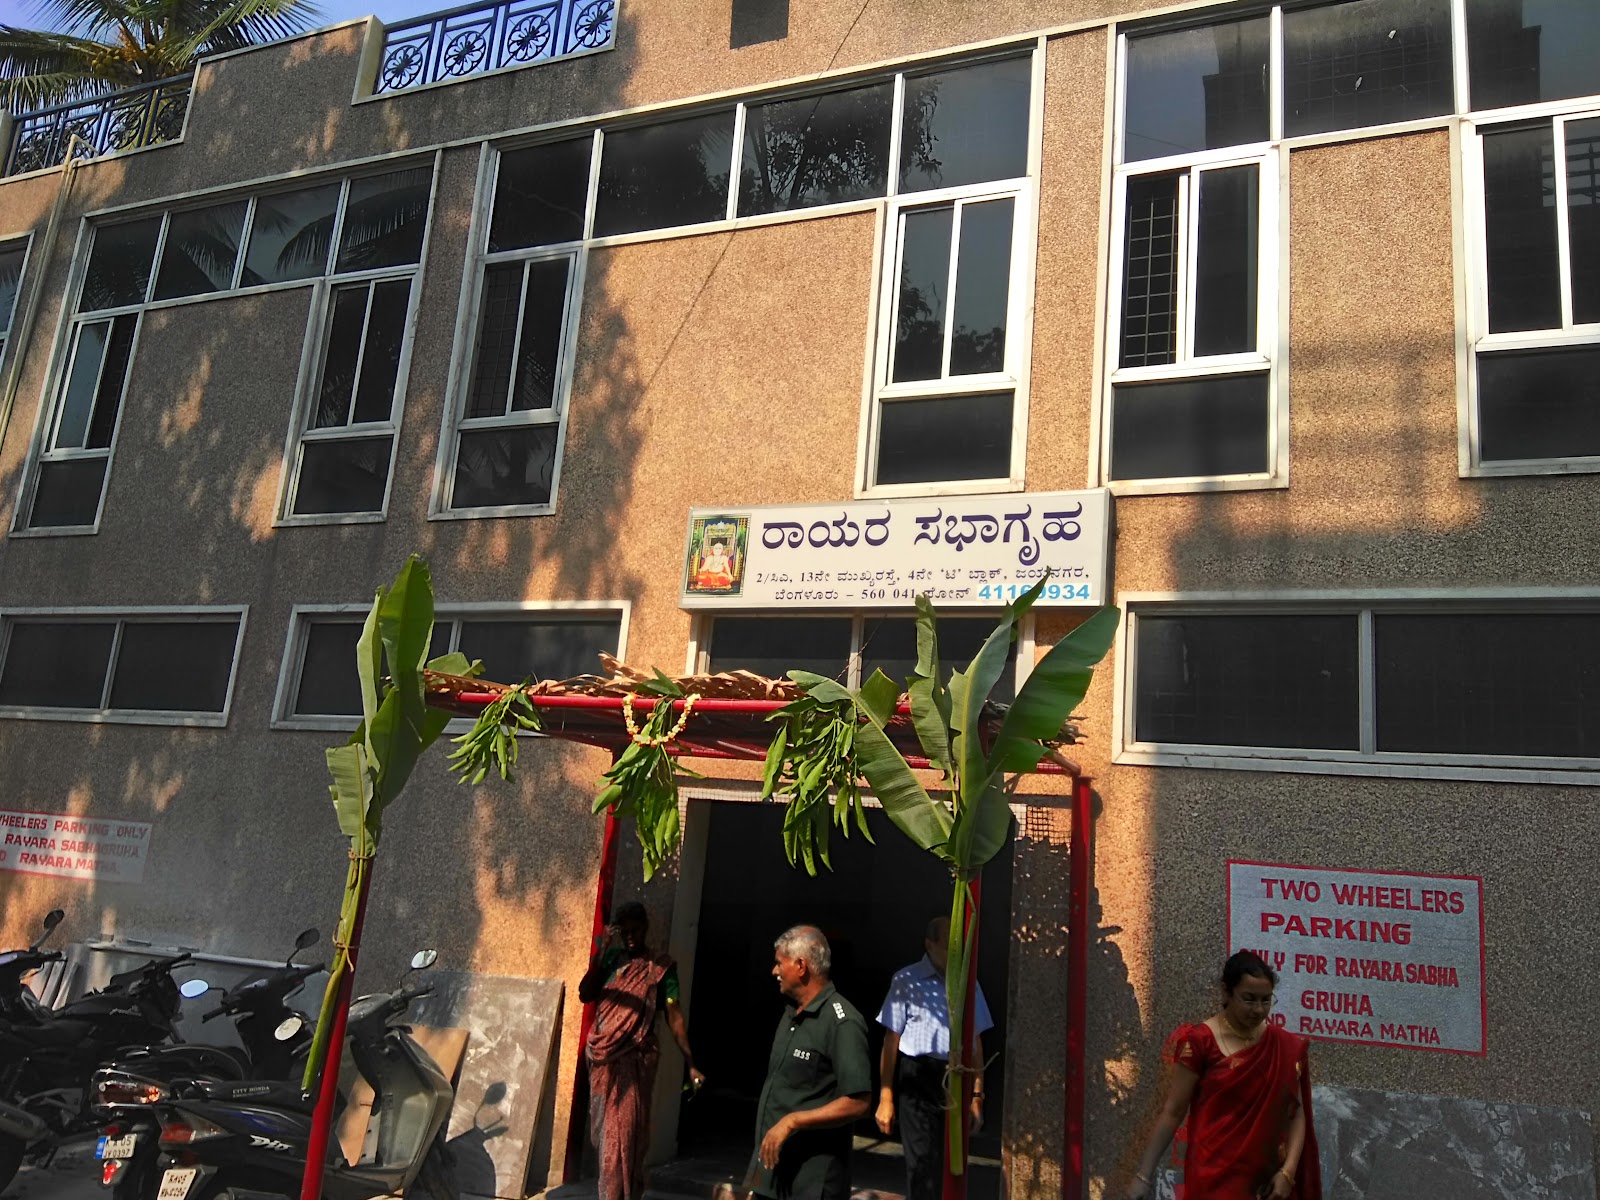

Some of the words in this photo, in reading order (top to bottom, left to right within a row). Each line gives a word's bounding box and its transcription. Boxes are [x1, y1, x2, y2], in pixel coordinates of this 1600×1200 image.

[762, 509, 891, 549] ರಾಯರ
[914, 501, 1083, 566] ಸಭಾಗೃಹ
[800, 570, 830, 583] 13ನೇ
[908, 568, 932, 580] 4ನೇ
[775, 588, 838, 600] ಬೆಂಗಳೂರು
[861, 589, 885, 600] 560
[893, 588, 915, 599] 041
[5, 834, 56, 850] RAYARA
[54, 820, 109, 836] PARKING
[116, 826, 148, 840] ONLY
[19, 853, 72, 869] RAYARA
[1261, 878, 1321, 902] TWO
[1331, 883, 1464, 914] WHEELERS
[1261, 912, 1411, 945] PARKING
[1240, 948, 1285, 971] LY
[1294, 953, 1328, 975] FOR
[1301, 990, 1373, 1017] GRUHA
[1265, 1013, 1286, 1029] ND
[1300, 1016, 1374, 1038] RAYARA
[1380, 1023, 1441, 1045] MATHA
